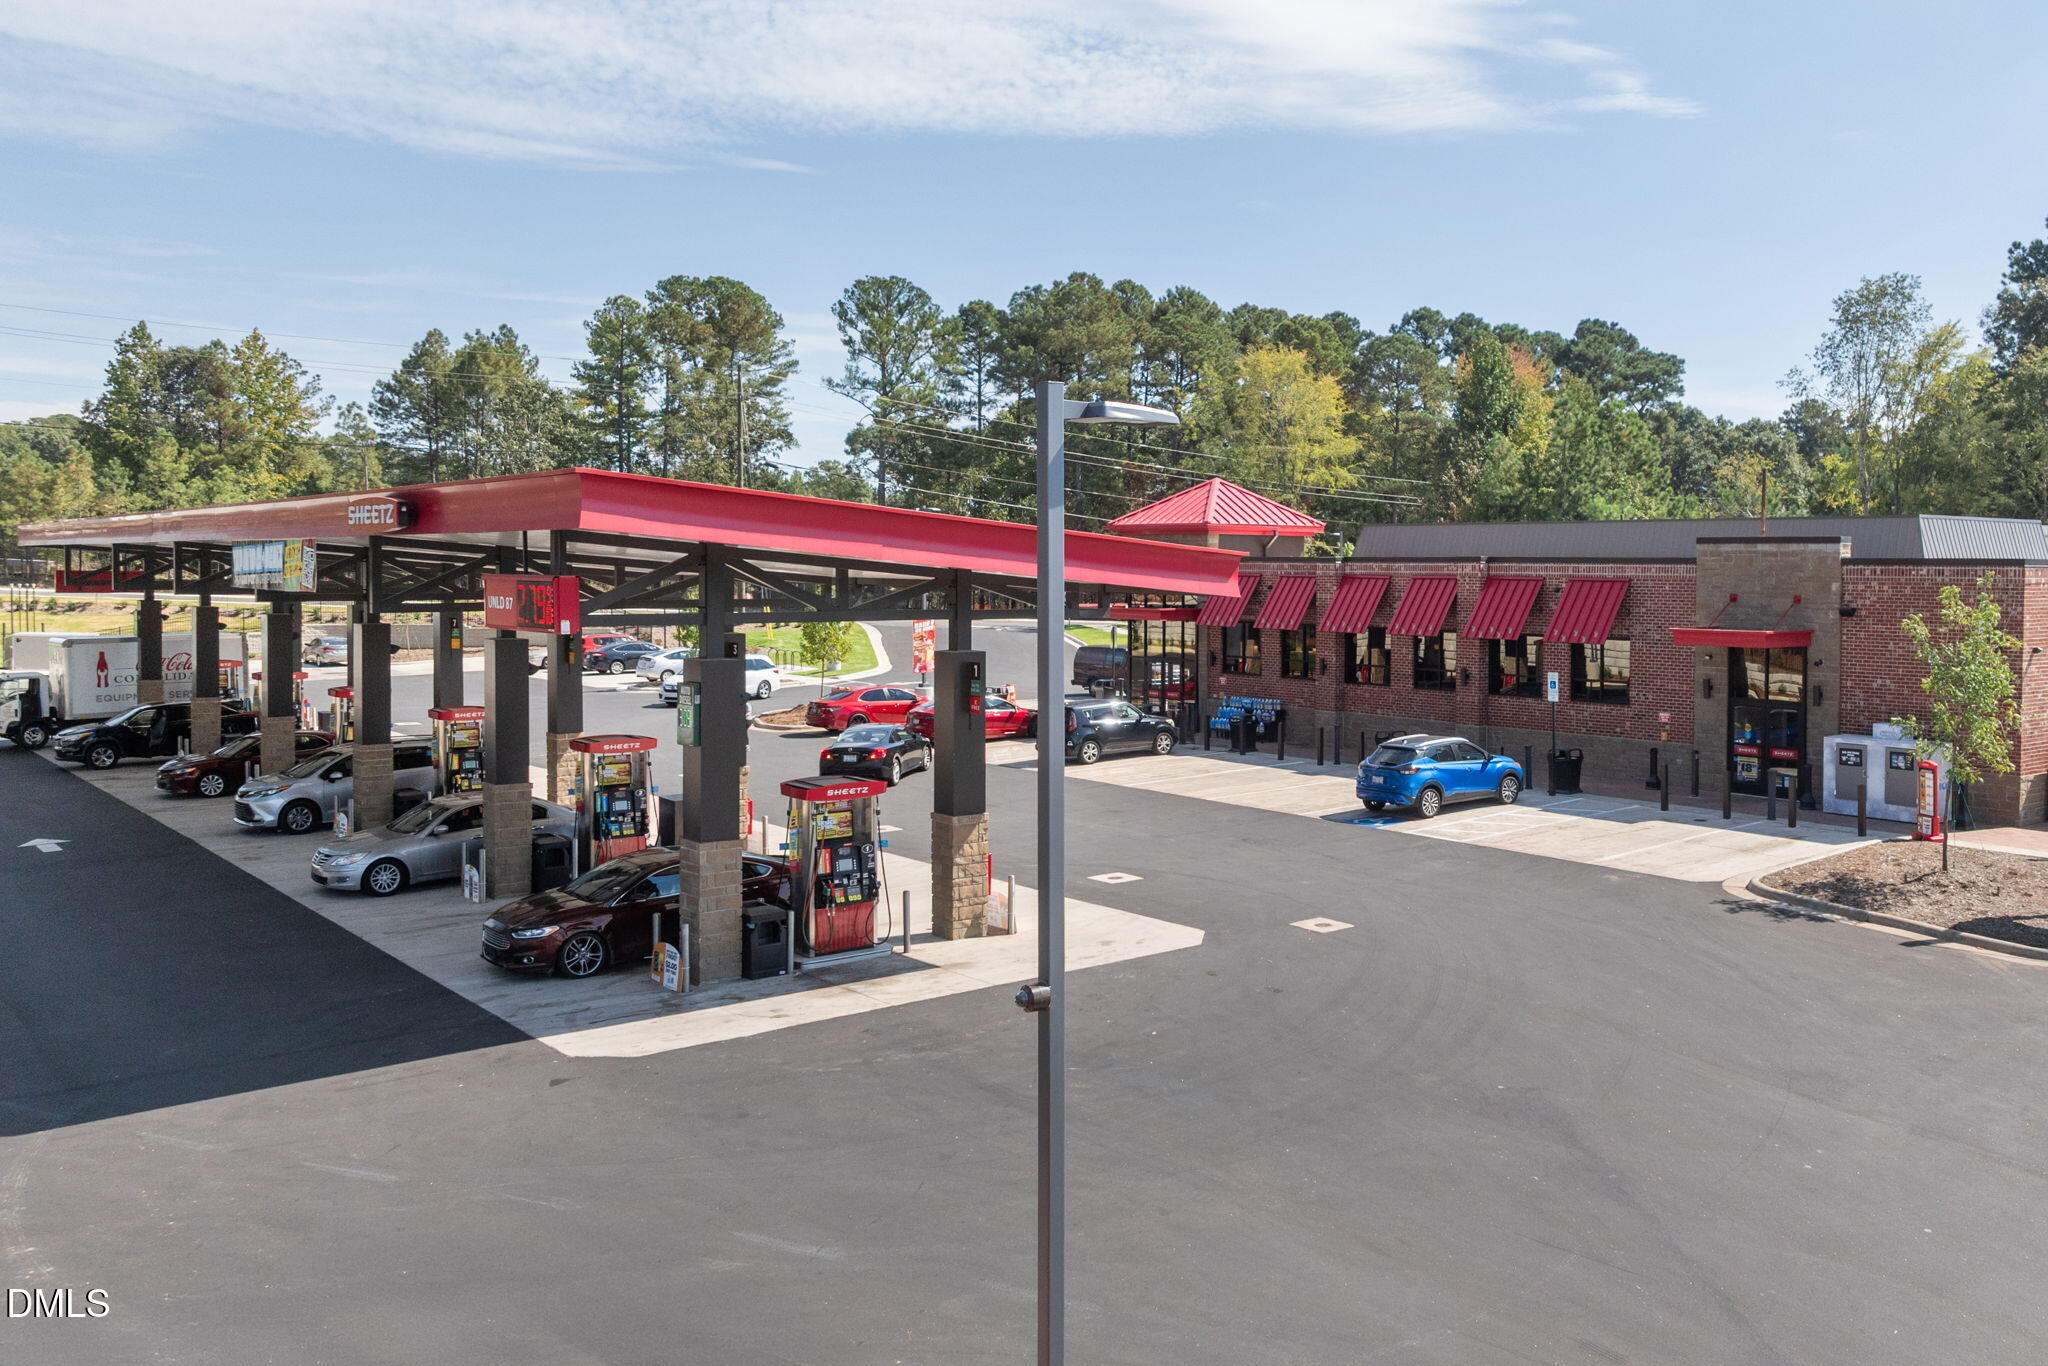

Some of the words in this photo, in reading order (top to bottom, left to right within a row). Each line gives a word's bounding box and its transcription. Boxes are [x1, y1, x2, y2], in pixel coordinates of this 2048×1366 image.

[348, 504, 394, 525] SHEETZ
[487, 596, 505, 609] UNLD
[505, 597, 514, 610] 87
[452, 618, 457, 627] 7
[732, 644, 738, 655] 3
[973, 664, 978, 678] 1
[603, 742, 641, 750] SHEETZ
[827, 787, 869, 796] SHEETZ
